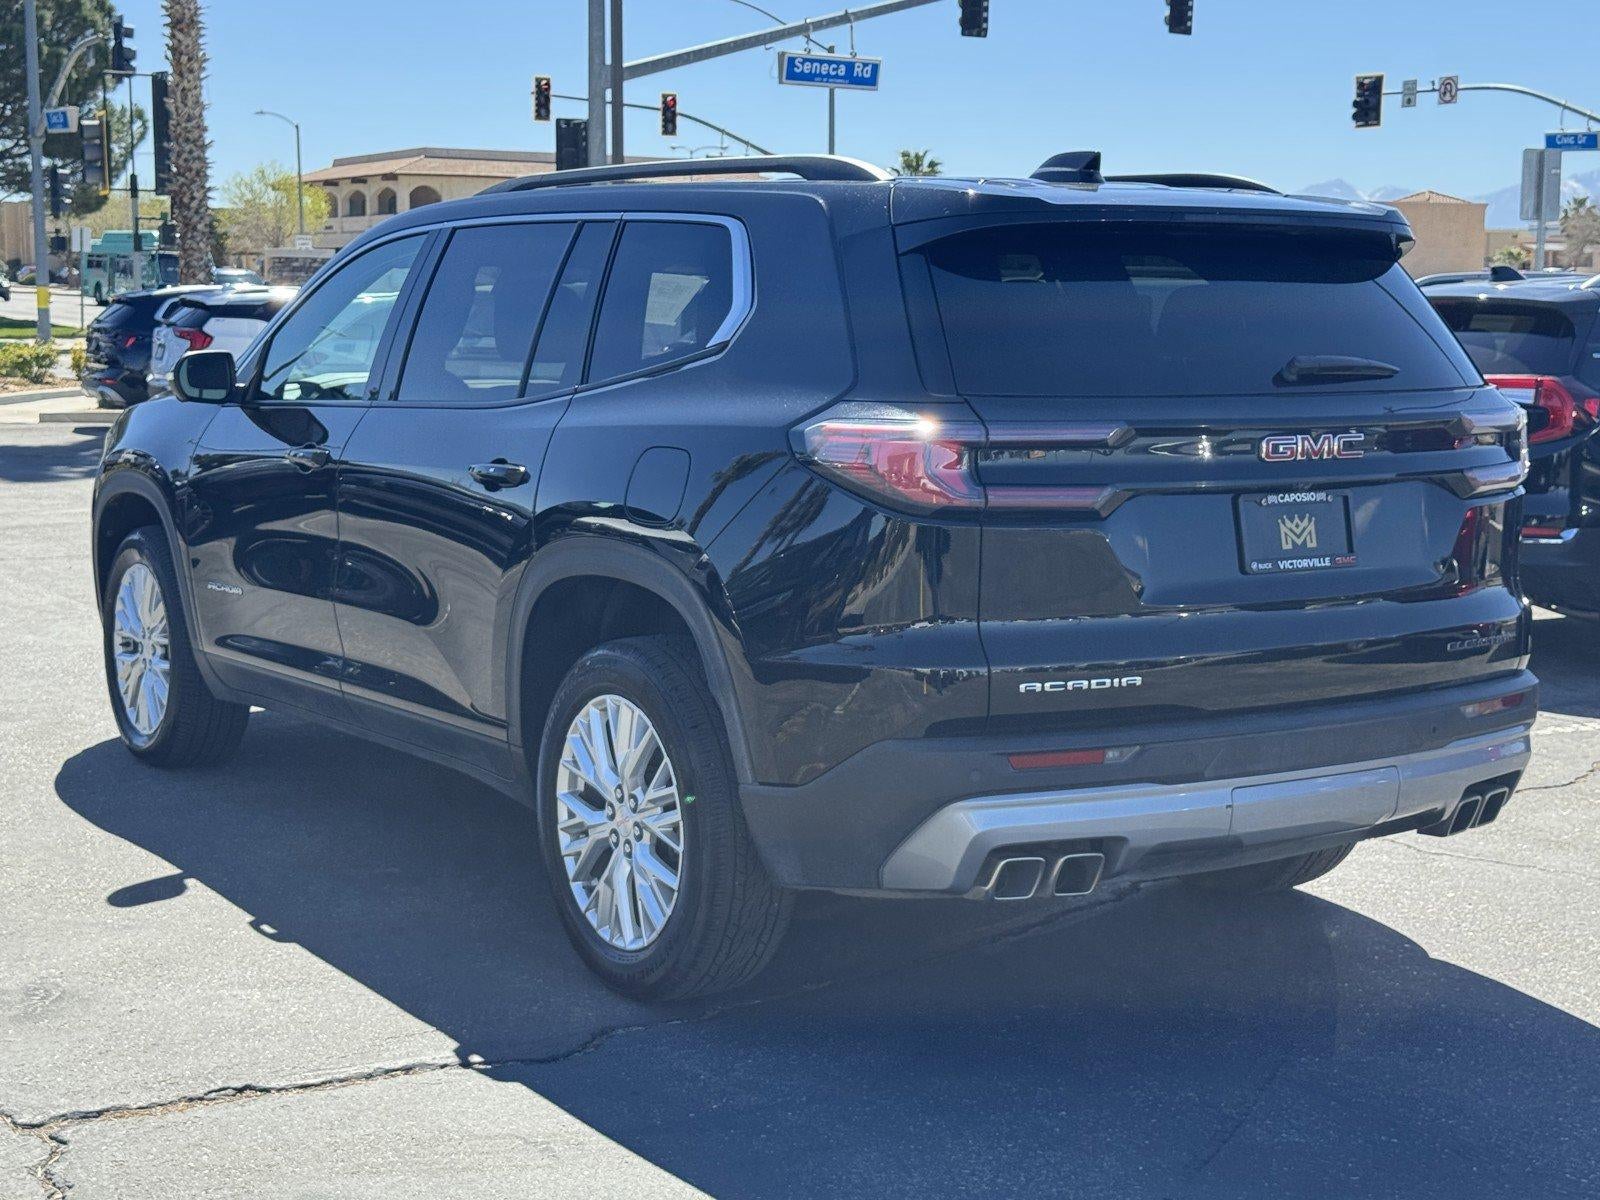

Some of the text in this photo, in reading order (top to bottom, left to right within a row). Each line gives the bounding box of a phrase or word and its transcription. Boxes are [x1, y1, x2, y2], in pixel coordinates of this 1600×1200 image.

[794, 58, 872, 78] Seneca Rd
[1262, 434, 1364, 461] GMC
[1278, 492, 1315, 503] CAPOSIO
[1278, 557, 1331, 569] VICTORVILLE
[1019, 676, 1142, 693] ACADIA
